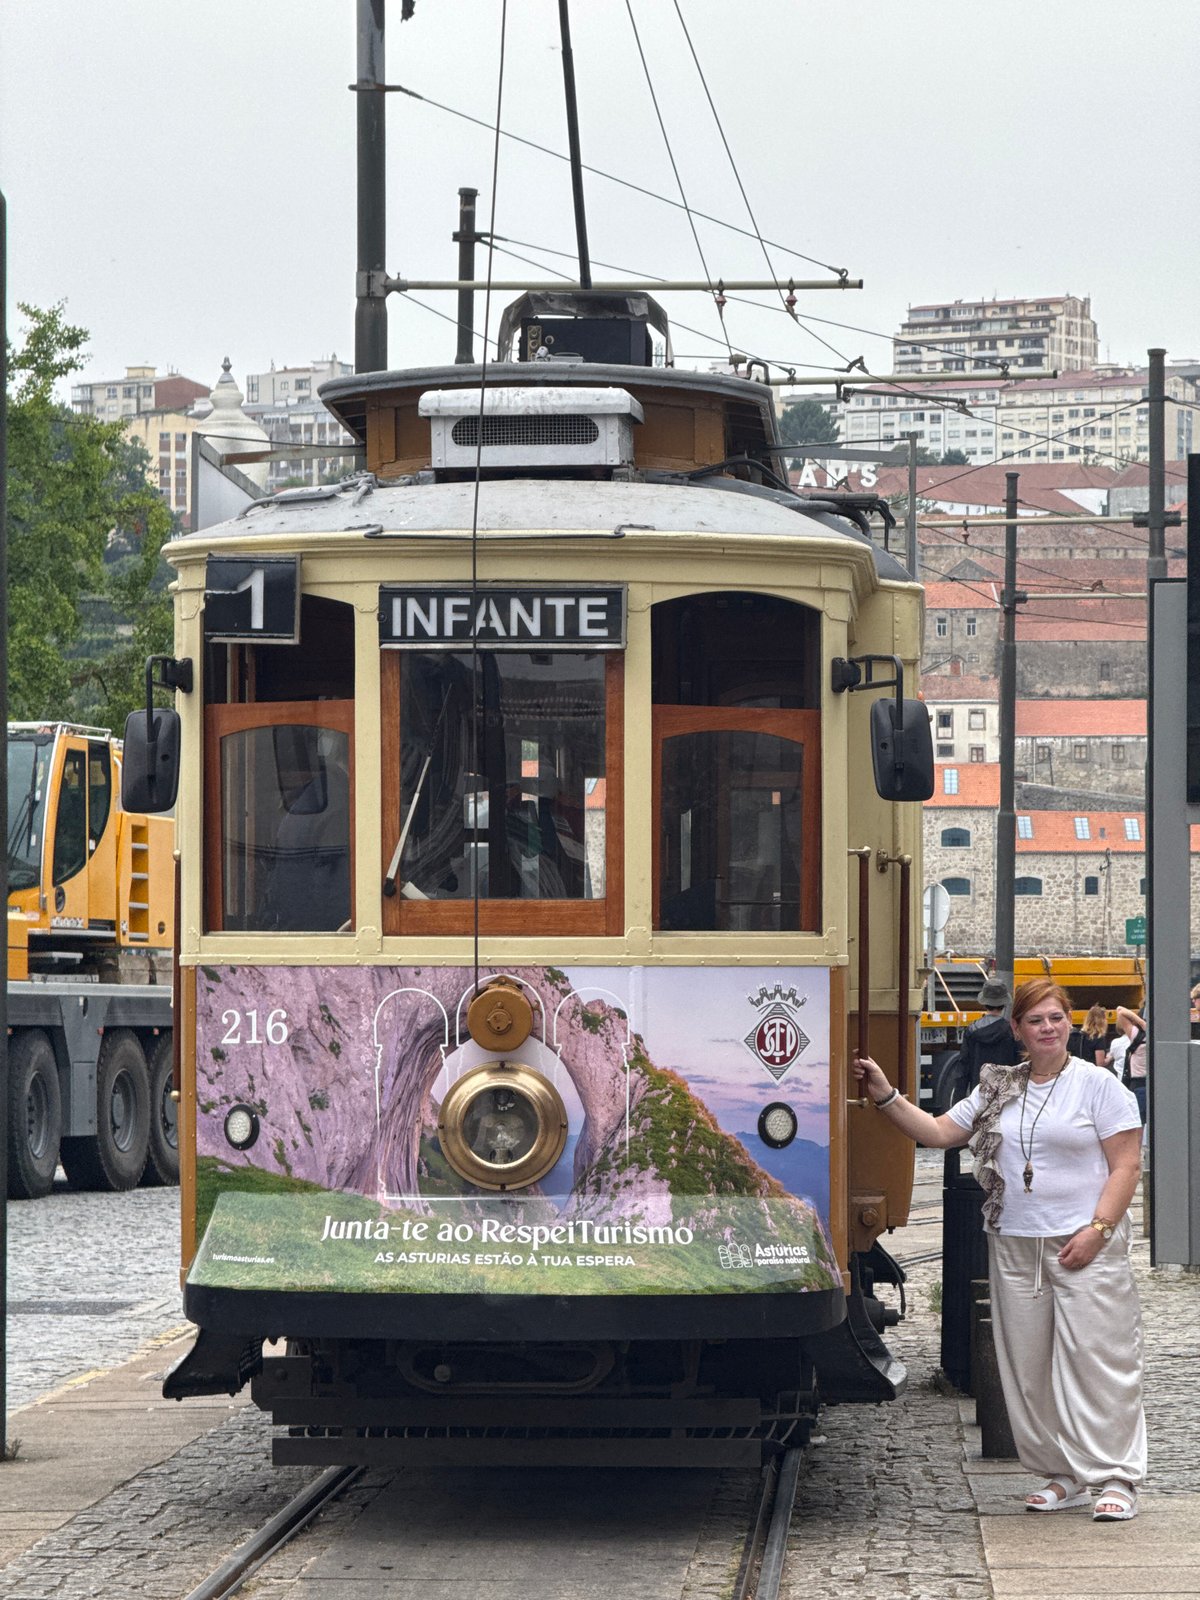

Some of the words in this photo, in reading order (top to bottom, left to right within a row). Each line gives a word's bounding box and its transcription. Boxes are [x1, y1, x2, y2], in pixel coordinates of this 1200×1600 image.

[236, 568, 265, 630] 1
[392, 596, 609, 637] INFANTE
[220, 1008, 289, 1045] 216
[320, 1215, 429, 1242] Junta-te
[437, 1222, 474, 1242] ao
[481, 1219, 694, 1251] RespeiTurismo
[212, 1253, 275, 1264] turismoasturias.es
[374, 1252, 394, 1264] AS
[396, 1252, 471, 1265] ASTURIAS
[474, 1252, 524, 1266] ESTÃO
[526, 1252, 538, 1267] À
[541, 1255, 572, 1267] TUA
[576, 1255, 636, 1267] ESPERA
[755, 1243, 808, 1257] Astúrias
[785, 1256, 811, 1264] natural
